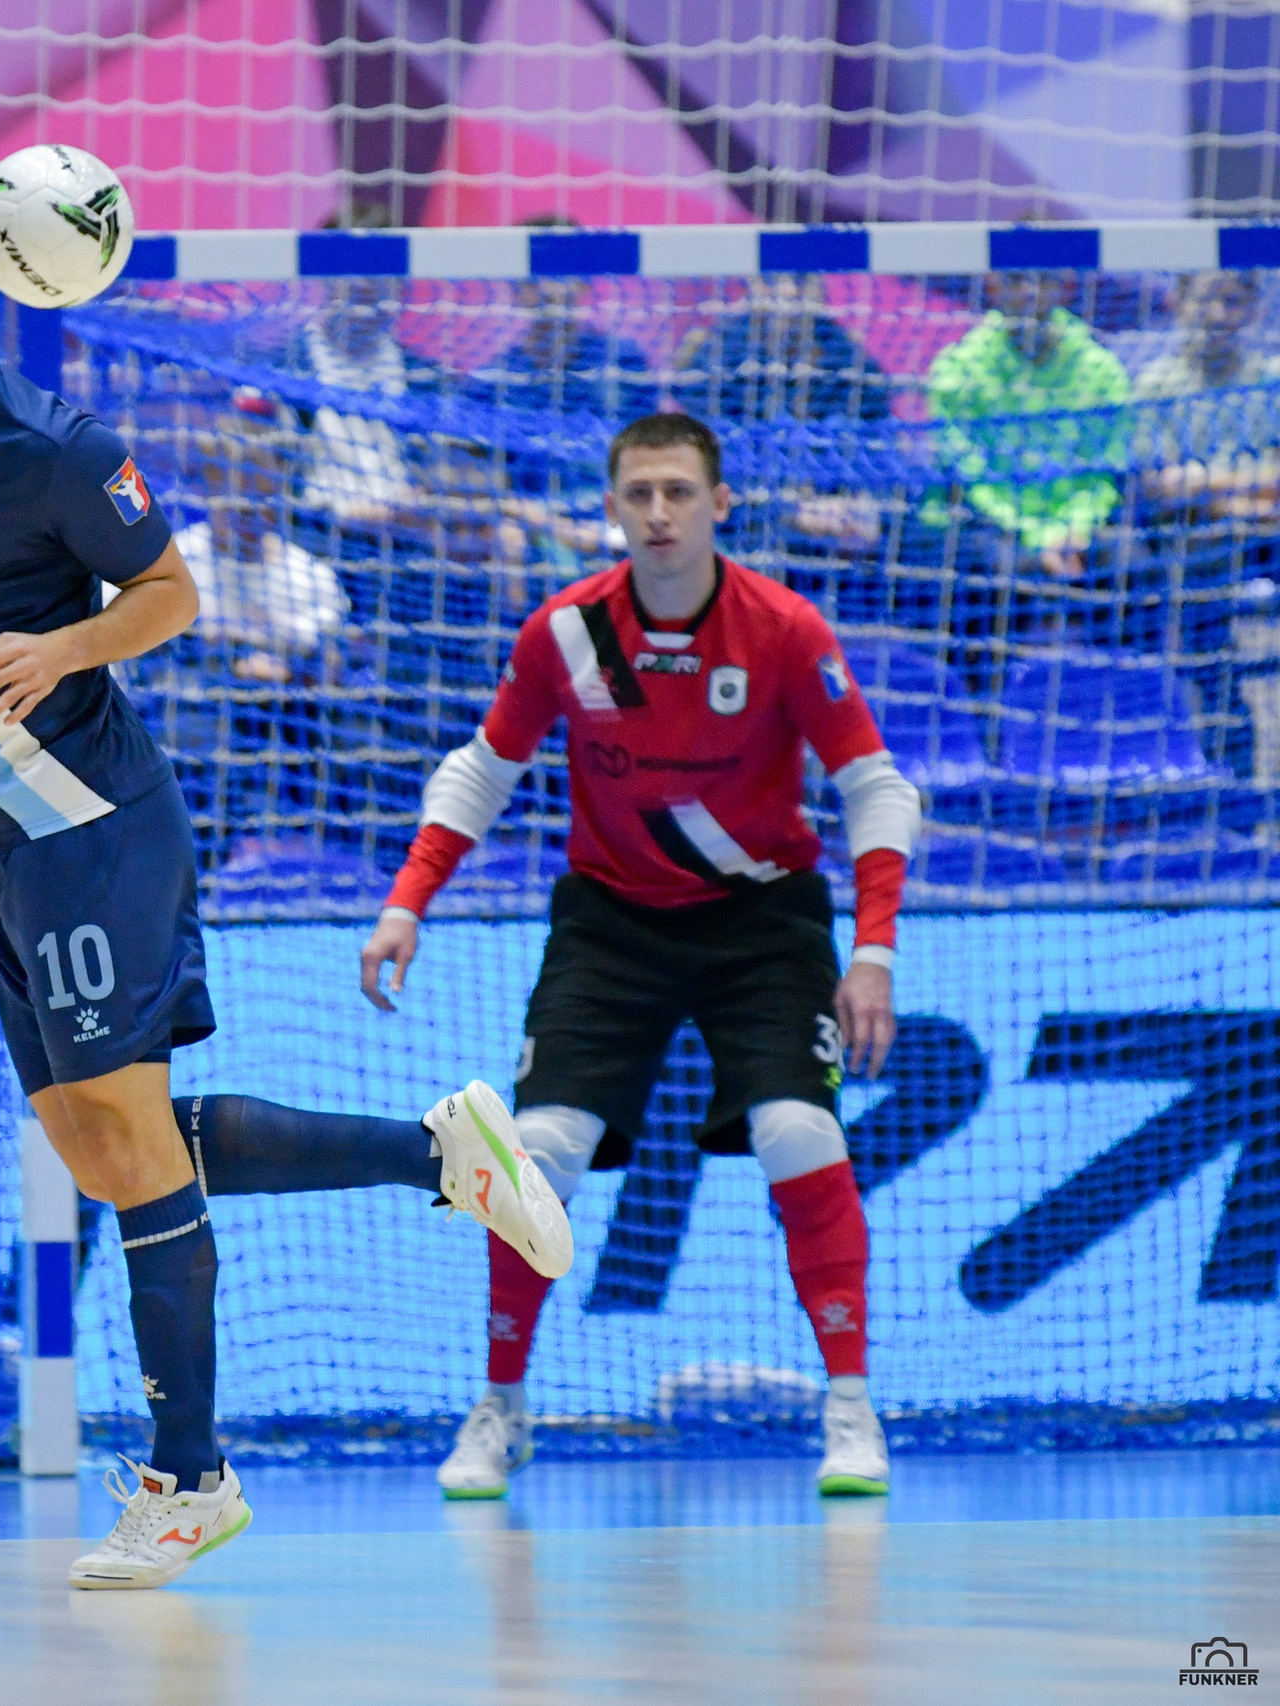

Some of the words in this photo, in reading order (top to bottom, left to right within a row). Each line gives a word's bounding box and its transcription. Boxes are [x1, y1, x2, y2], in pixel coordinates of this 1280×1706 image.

[37, 923, 116, 1010] 10
[73, 1025, 111, 1044] KELME
[811, 1012, 846, 1072] 3
